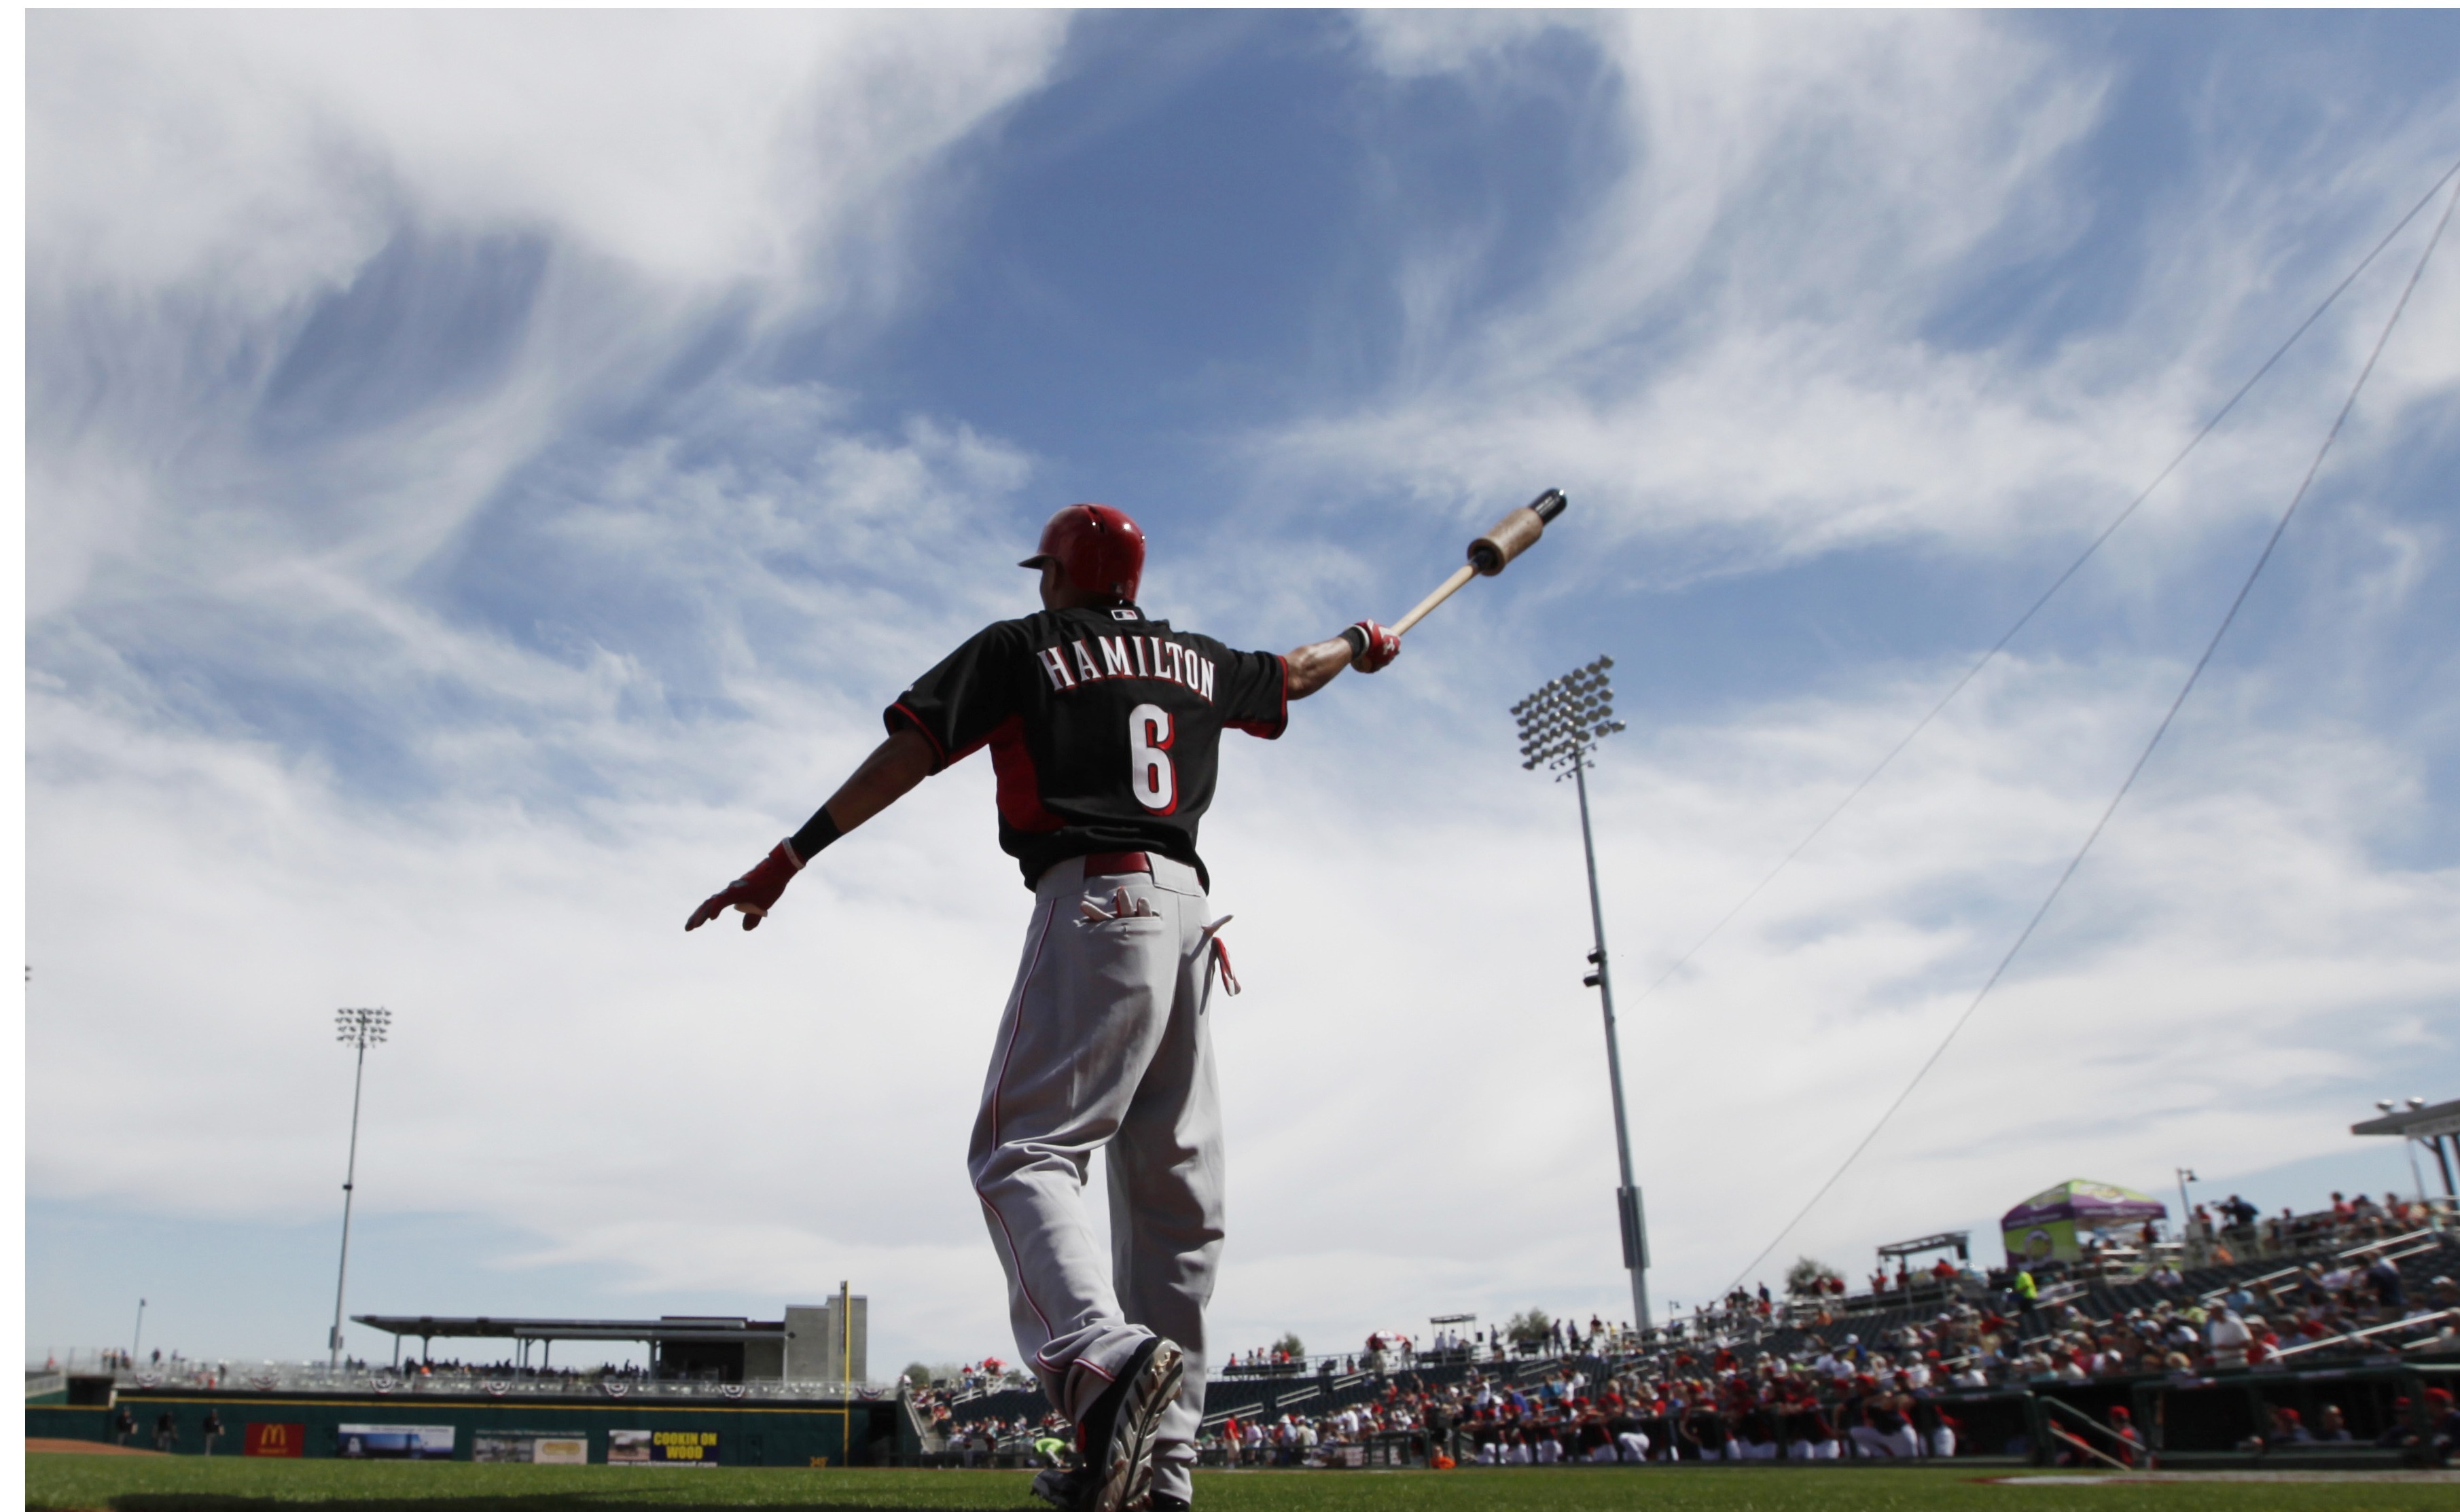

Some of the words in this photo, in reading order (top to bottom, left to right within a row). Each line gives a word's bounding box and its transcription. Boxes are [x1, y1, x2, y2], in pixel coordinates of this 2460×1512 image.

[1037, 634, 1215, 704] HAMILTON
[1128, 702, 1178, 816] 6
[653, 1432, 698, 1446] COOKIN
[700, 1433, 717, 1446] ON
[666, 1446, 703, 1459] WOOD
